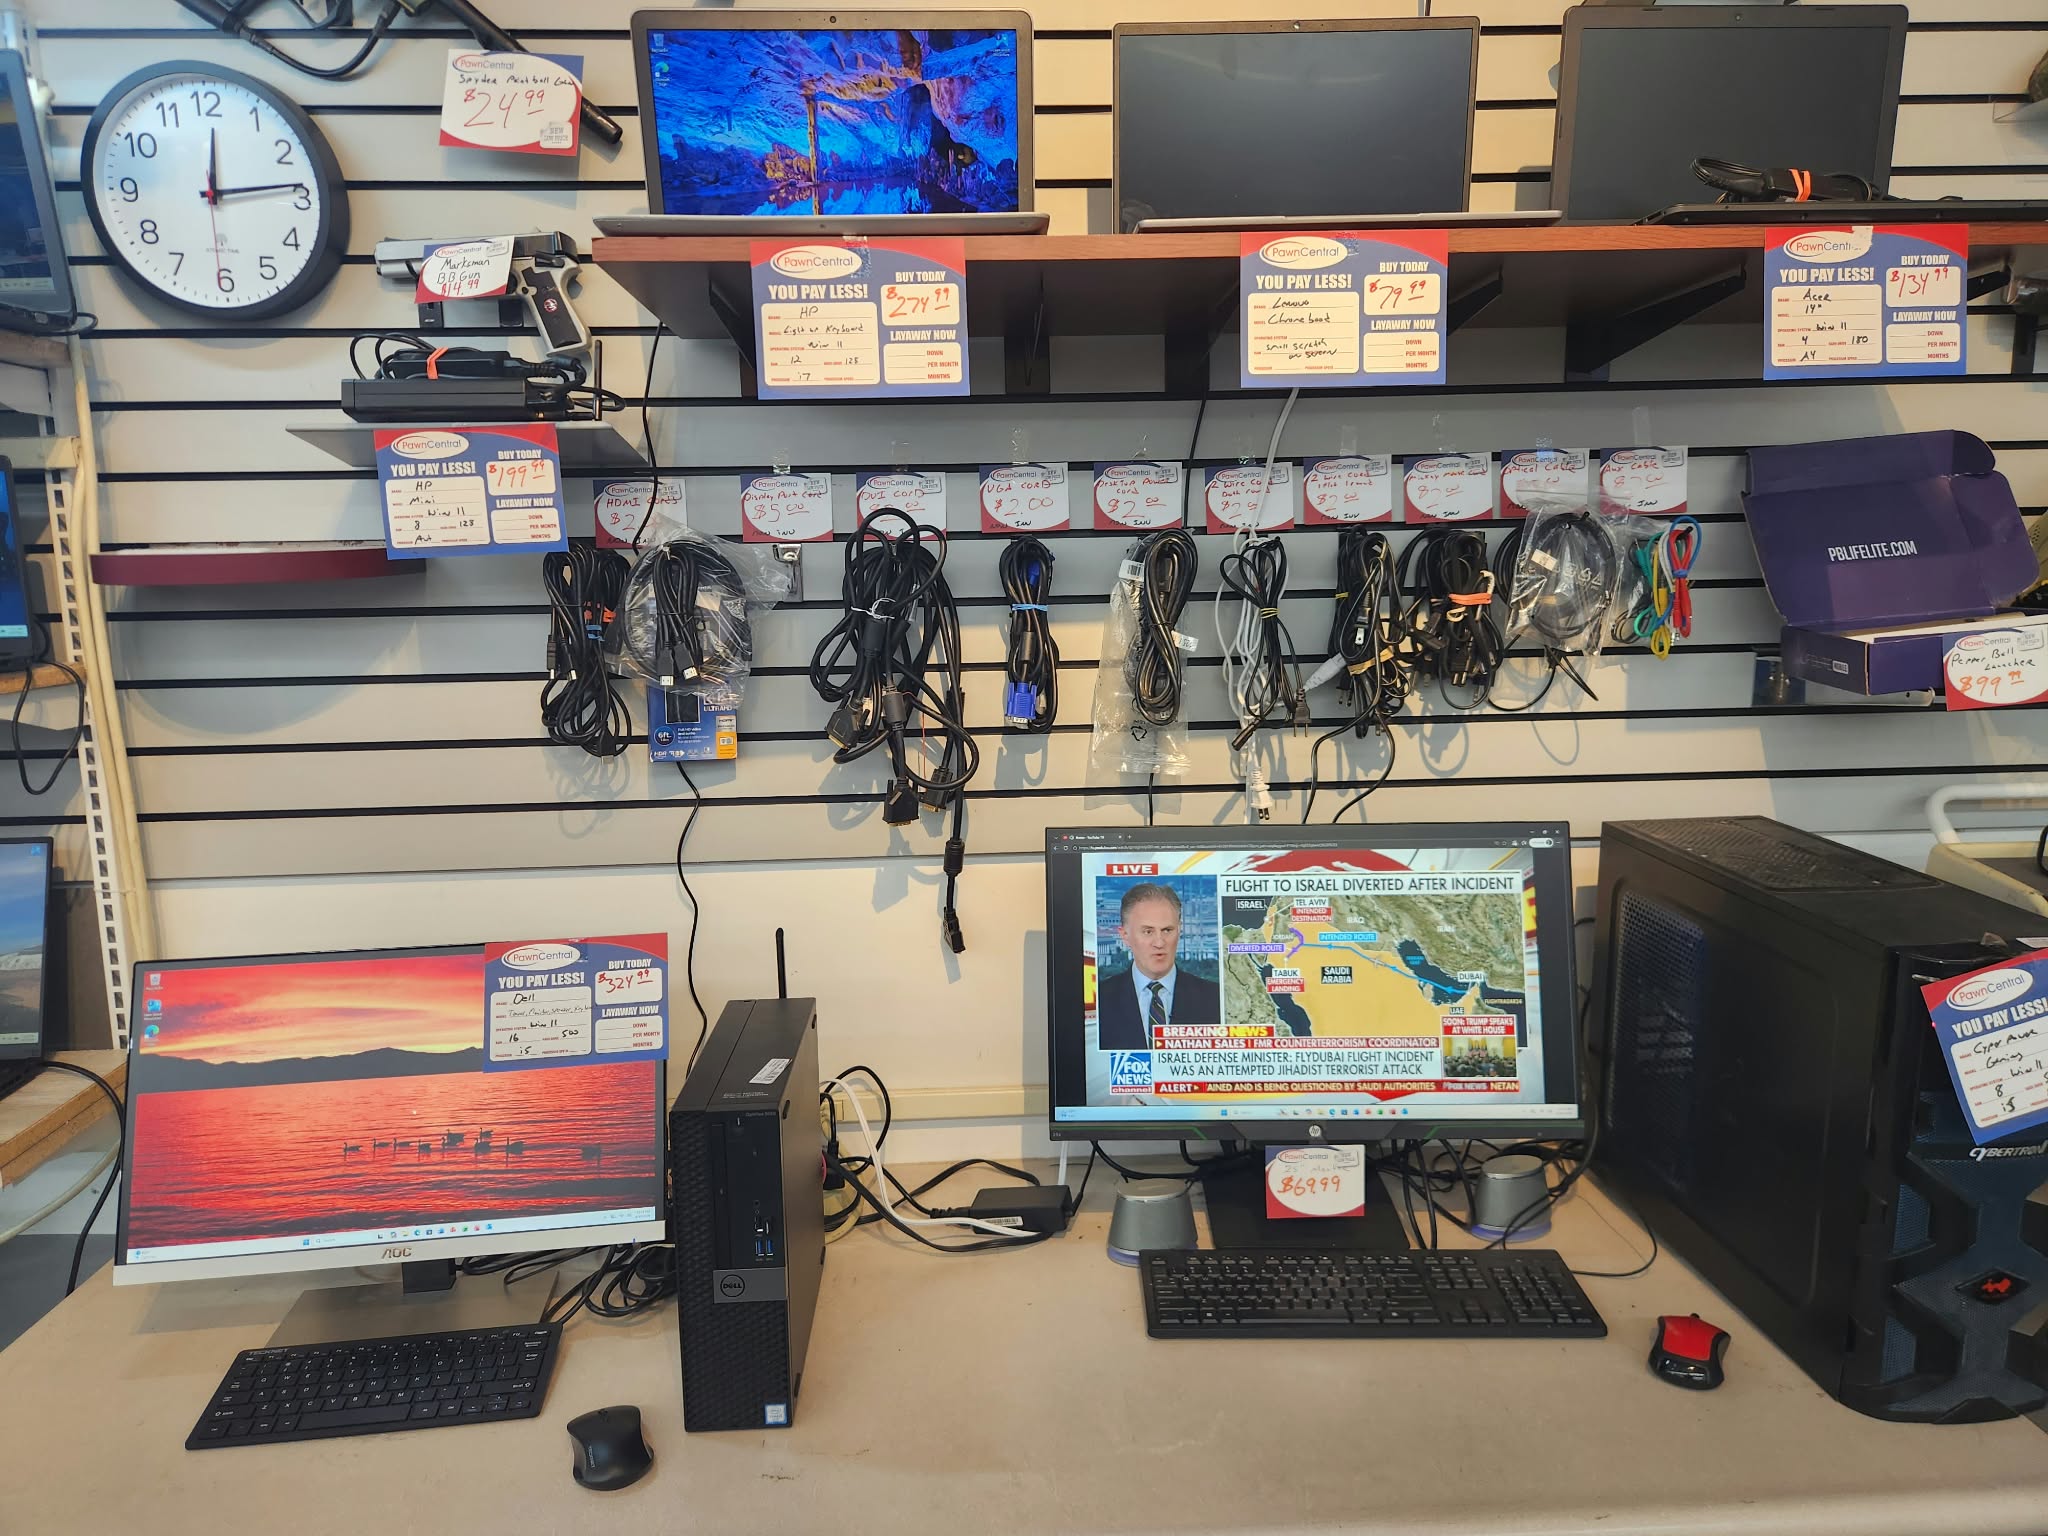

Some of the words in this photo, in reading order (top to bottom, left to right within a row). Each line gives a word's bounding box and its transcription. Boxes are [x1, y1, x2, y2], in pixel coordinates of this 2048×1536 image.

[460, 59, 515, 70] PawnCentral
[190, 90, 222, 117] 12
[156, 102, 179, 128] 11
[249, 107, 260, 132] 1
[124, 132, 157, 158] 10
[275, 140, 293, 165] 2
[120, 177, 138, 202] 9
[293, 184, 311, 210] 3
[140, 219, 159, 244] 8
[282, 227, 300, 251] 4
[441, 247, 481, 255] PawnCentral
[1273, 247, 1338, 257] PawnCentral
[169, 252, 184, 276] 7
[441, 257, 490, 269] Marksman
[784, 256, 853, 267] PawnCentral
[1901, 256, 1919, 265] BUY
[1921, 255, 1950, 264] TODAY
[259, 256, 276, 280] 5
[1380, 262, 1397, 272] BUY
[1400, 262, 1428, 271] TODAY
[217, 269, 234, 292] 6
[896, 272, 914, 282] BUY
[916, 271, 946, 281] TODAY
[1780, 270, 1807, 283] YOU
[1810, 269, 1834, 282] PAY
[1838, 267, 1874, 281] LESS!
[1256, 275, 1284, 289] YOU
[1287, 275, 1312, 289] PAY
[1315, 274, 1352, 288] LESS!
[768, 285, 797, 299] YOU
[802, 285, 827, 299] PAY
[830, 284, 868, 298] LESS!
[800, 306, 818, 318] HP
[1893, 312, 1932, 321] LAYAWAY
[1935, 311, 1956, 320] NOW
[1371, 321, 1411, 330] LAYAWAY
[1413, 320, 1435, 330] NOW
[890, 330, 932, 341] LAYAWAY
[933, 330, 957, 340] NOW
[402, 440, 461, 449] PawnCentral
[498, 451, 513, 460] BUY
[515, 449, 541, 459] TODAY
[391, 464, 415, 477] YOU
[418, 463, 440, 475] PAY
[442, 462, 476, 474] LESS!
[416, 481, 432, 491] HP
[496, 499, 532, 508] LAYAWAY
[533, 498, 553, 506] NOW
[606, 498, 640, 507] HDMI
[1828, 540, 1918, 562] PBLIFELITE.COM
[1964, 638, 2011, 646] PawnCentral
[1113, 865, 1152, 874] LIVE
[1226, 880, 1269, 892] FLIGHT
[1273, 880, 1291, 891] TO
[1296, 880, 1338, 891] ISRAEL
[1343, 878, 1403, 891] DIVERTED
[1408, 878, 1447, 890] AFTER
[1451, 877, 1514, 890] INCIDENT
[514, 951, 572, 962] PawnCentral
[609, 960, 625, 970] BUY
[627, 959, 651, 968] TODAY
[1325, 967, 1349, 975] SAUDI
[498, 976, 523, 989] YOU
[527, 974, 548, 987] PAY
[552, 972, 584, 986] LESS!
[1959, 974, 2025, 1002] PawnCentral
[602, 1007, 637, 1018] LAYAWAY
[639, 1006, 659, 1014] NOW
[1952, 1018, 1982, 1039] YOU
[1984, 1010, 2009, 1030] PAY
[509, 1034, 518, 1042] 16
[1163, 1027, 1228, 1037] BREAKING
[1229, 1027, 1268, 1036] NEWS
[1165, 1040, 1212, 1048] NATHAN
[1215, 1039, 1246, 1048] SALES
[1254, 1039, 1273, 1047] FMR
[1275, 1038, 1366, 1047] COUNTERTERRORISM
[1368, 1038, 1438, 1047] COORDINATOR
[1158, 1054, 1191, 1063] ISRAEL
[1194, 1053, 1238, 1062] DEFENSE
[1242, 1053, 1292, 1062] MINISTER:
[1296, 1052, 1344, 1063] FLYDUBAI
[1347, 1052, 1382, 1062] FLIGHT
[1385, 1051, 1434, 1061] INCIDENT
[1124, 1062, 1150, 1072] FOX
[1170, 1066, 1196, 1076] WAS
[1198, 1066, 1214, 1075] AN
[1217, 1065, 1275, 1075] ATTEMPTED
[1278, 1065, 1322, 1075] JIHADIST
[1326, 1065, 1380, 1075] TERRORIST
[1383, 1064, 1422, 1074] ATTACK
[1117, 1073, 1151, 1084] NEWS
[1159, 1084, 1192, 1092] ALERT
[1264, 1083, 1288, 1091] BEING
[1290, 1082, 1342, 1091] QUESTIONED
[1384, 1082, 1436, 1090] AUTHORITIES
[1490, 1082, 1519, 1090] NETAN
[1278, 1175, 1340, 1196] $69.99
[381, 1247, 412, 1259] AOC
